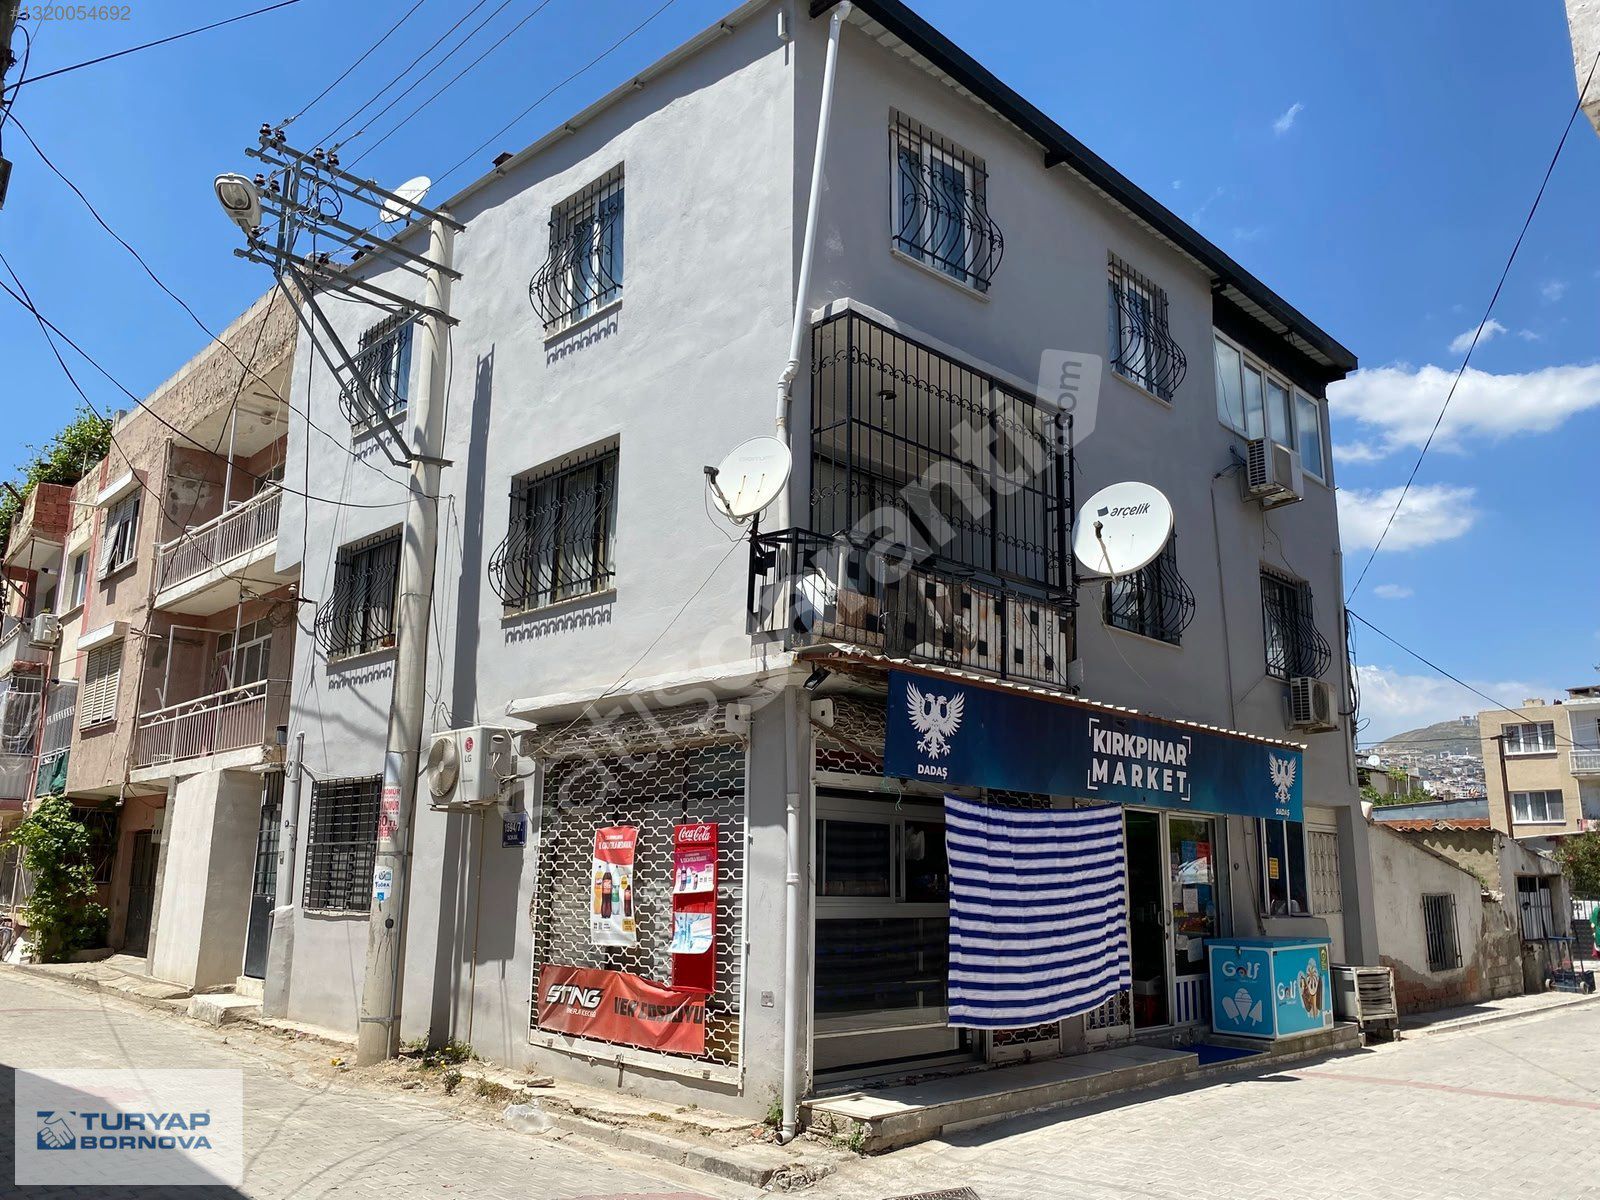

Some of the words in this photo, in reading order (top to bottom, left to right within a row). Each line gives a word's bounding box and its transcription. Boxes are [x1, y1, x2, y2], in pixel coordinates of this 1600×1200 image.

[1110, 503, 1151, 519] arçelik
[1093, 728, 1187, 767] KIRKPINAR
[464, 754, 472, 763] LG
[917, 763, 948, 780] DADAŞ
[1092, 757, 1187, 793] MARKET
[1221, 960, 1261, 980] Golf
[546, 984, 601, 1010] STING
[1277, 979, 1298, 1001] Golf
